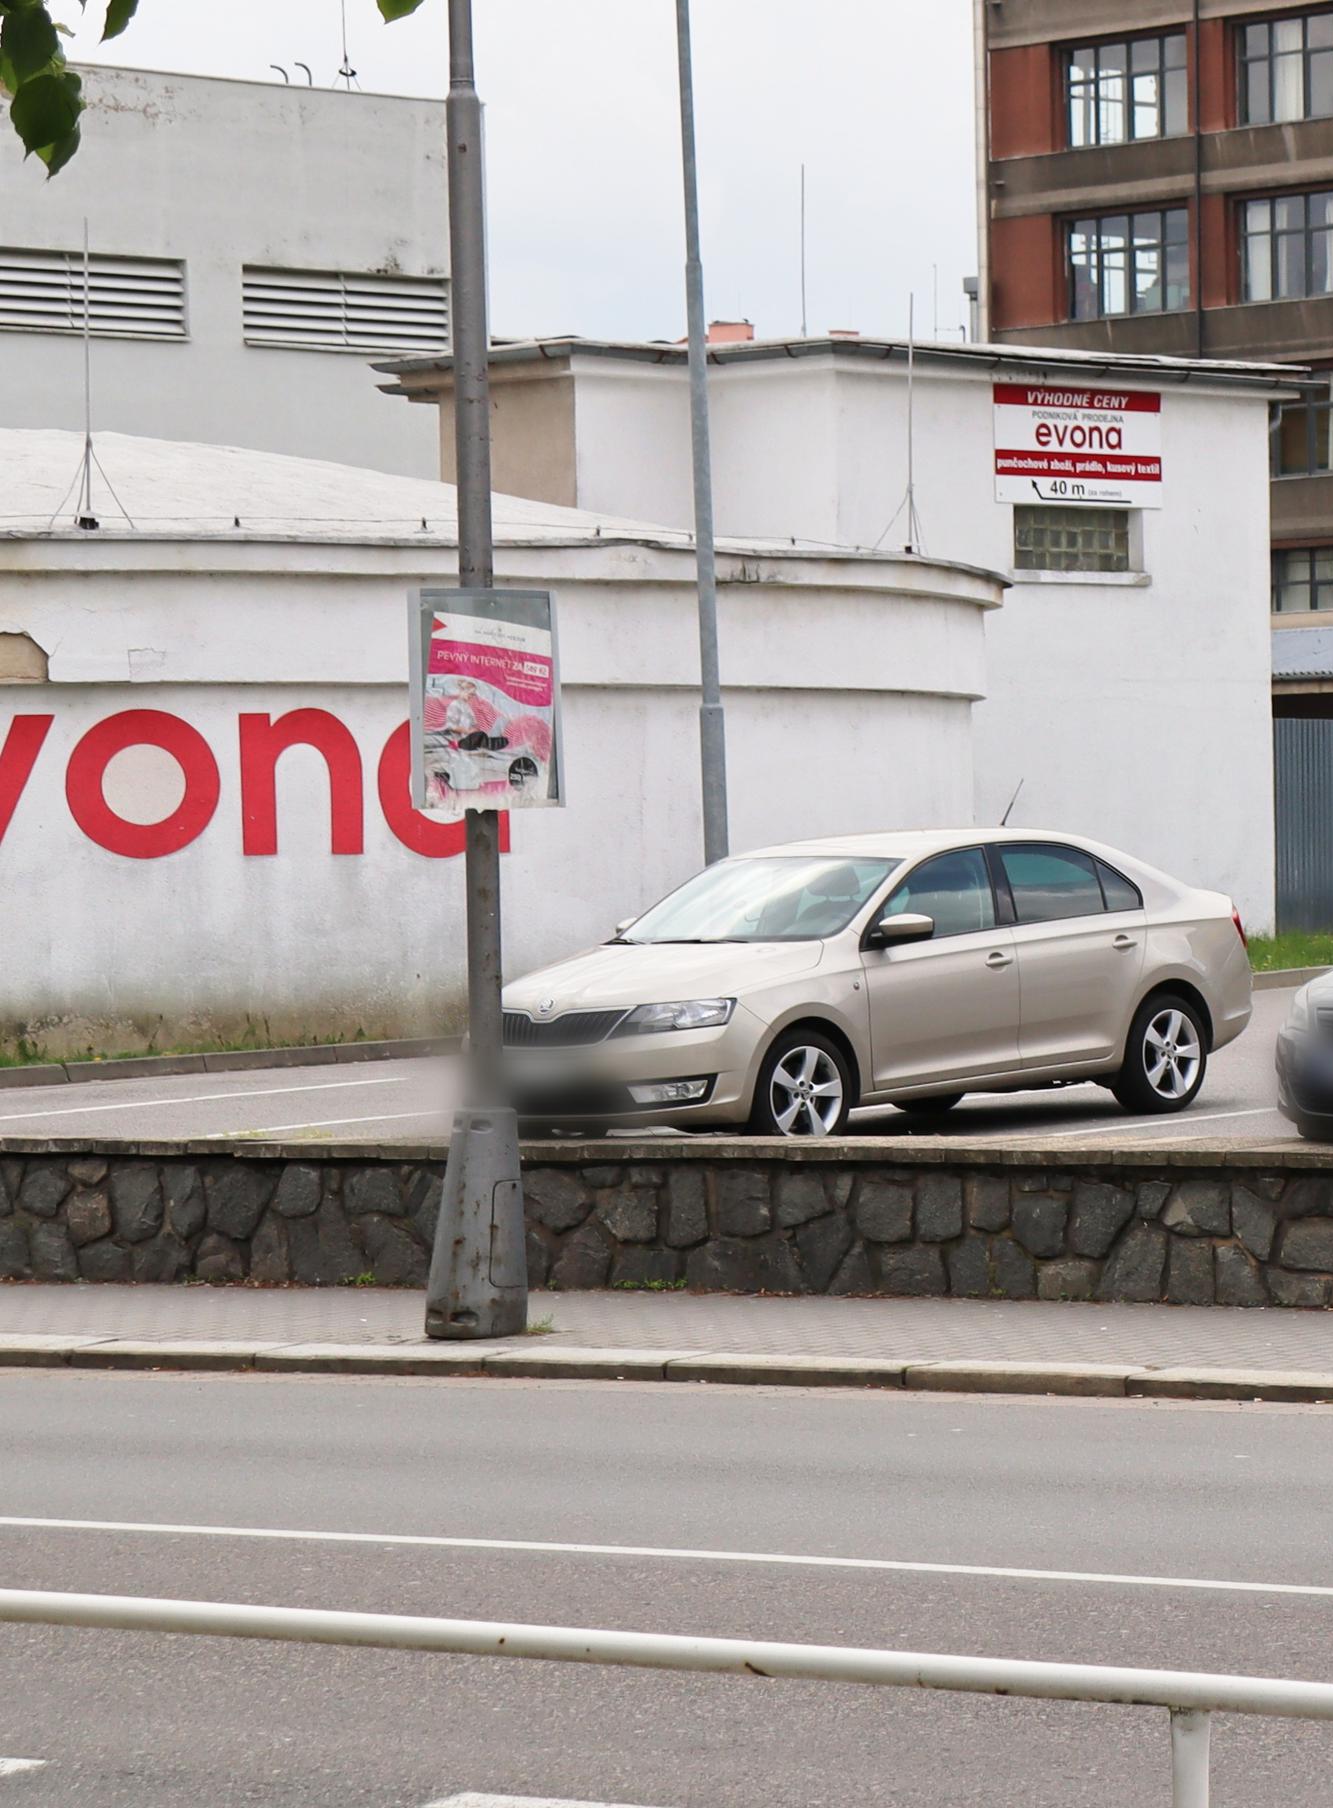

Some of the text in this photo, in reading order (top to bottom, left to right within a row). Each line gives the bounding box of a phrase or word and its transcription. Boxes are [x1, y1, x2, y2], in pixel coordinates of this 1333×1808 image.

[1027, 388, 1129, 409] VÝHODNÉ CENY
[1081, 413, 1124, 424] PRODEJNA
[1035, 422, 1122, 450] evona
[1138, 463, 1160, 475] textil
[1050, 480, 1067, 495] 40
[1072, 484, 1085, 496] m
[470, 655, 512, 669] INTERNET
[512, 661, 524, 671] ZA
